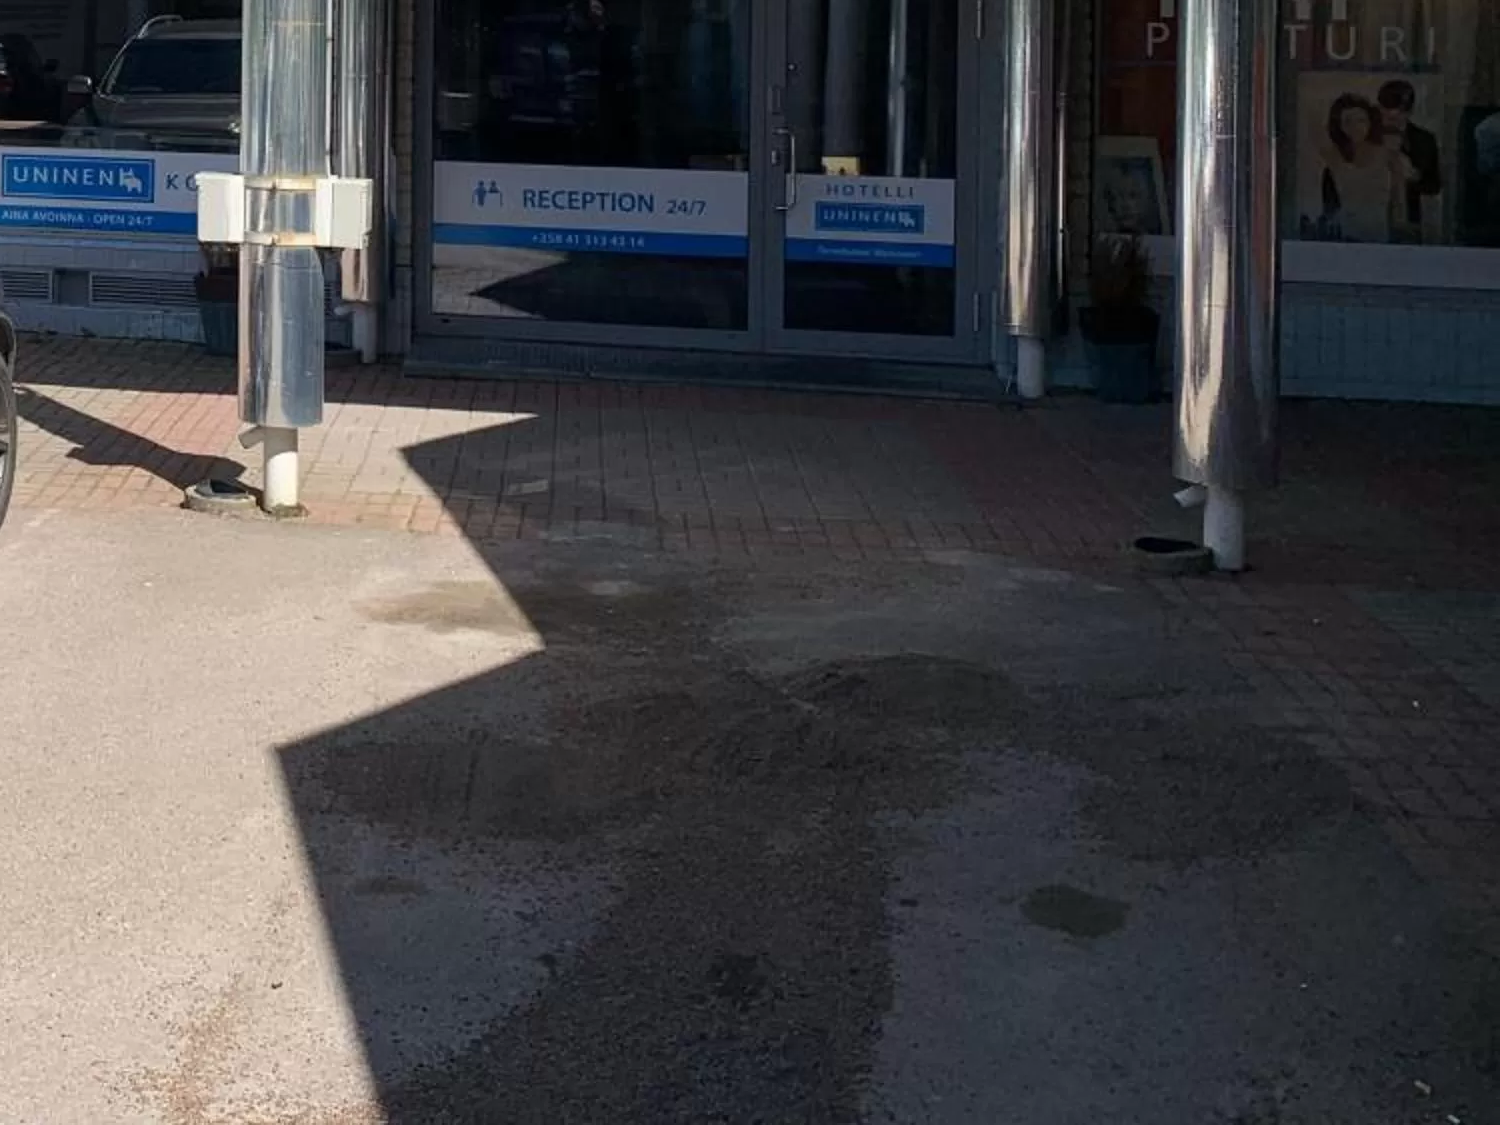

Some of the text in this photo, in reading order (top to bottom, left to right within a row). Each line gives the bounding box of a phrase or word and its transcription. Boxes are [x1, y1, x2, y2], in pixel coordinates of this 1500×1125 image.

[12, 166, 115, 187] UNINEN
[825, 182, 914, 199] HOTELLI
[522, 188, 707, 215] RECEPTION 24/7
[93, 214, 125, 225] OPEN
[128, 215, 154, 226] 24/7
[823, 209, 896, 224] UNINEN
